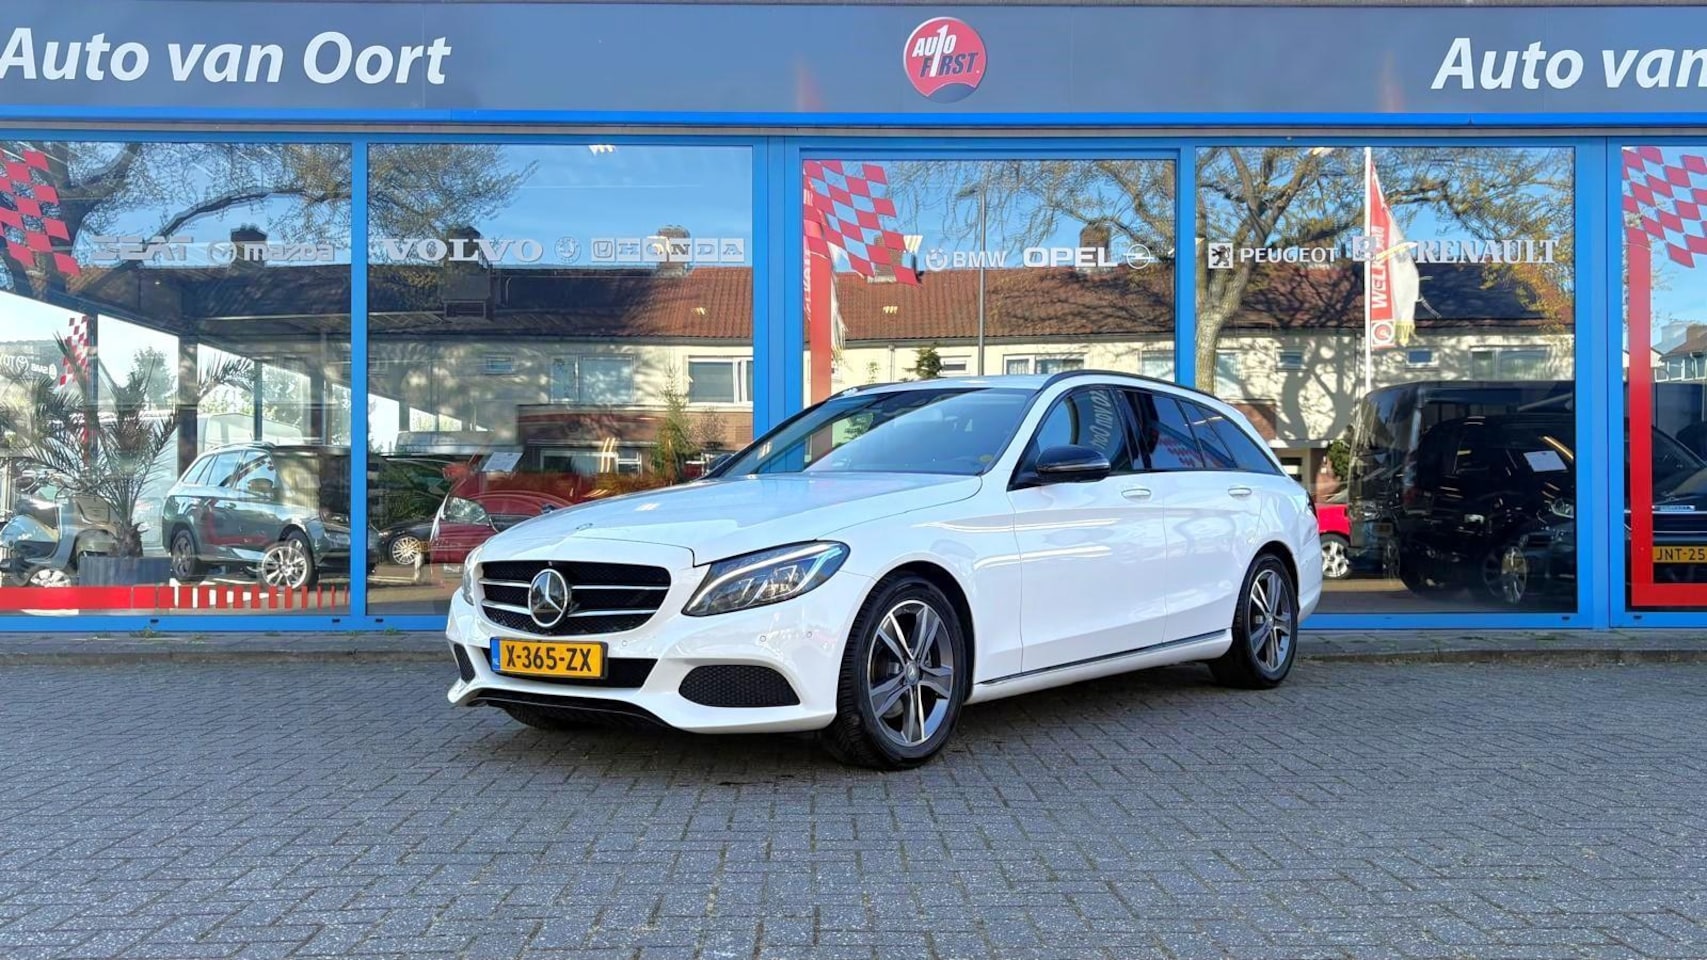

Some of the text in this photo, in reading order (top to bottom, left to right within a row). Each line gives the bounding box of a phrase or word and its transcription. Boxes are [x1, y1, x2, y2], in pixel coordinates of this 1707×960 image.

[0, 27, 452, 85] Auto van Oort
[1431, 37, 1707, 90] Auto van
[90, 236, 194, 261] SEAT
[380, 239, 543, 262] VOLVO
[617, 240, 743, 260] HONDA
[953, 251, 1008, 268] BMW
[1023, 247, 1118, 268] OPEL
[1240, 247, 1339, 263] PEUGEOT
[1415, 240, 1560, 263] RENAULT
[1656, 548, 1706, 561] JNT-25
[505, 645, 592, 673] X-365-ZX
